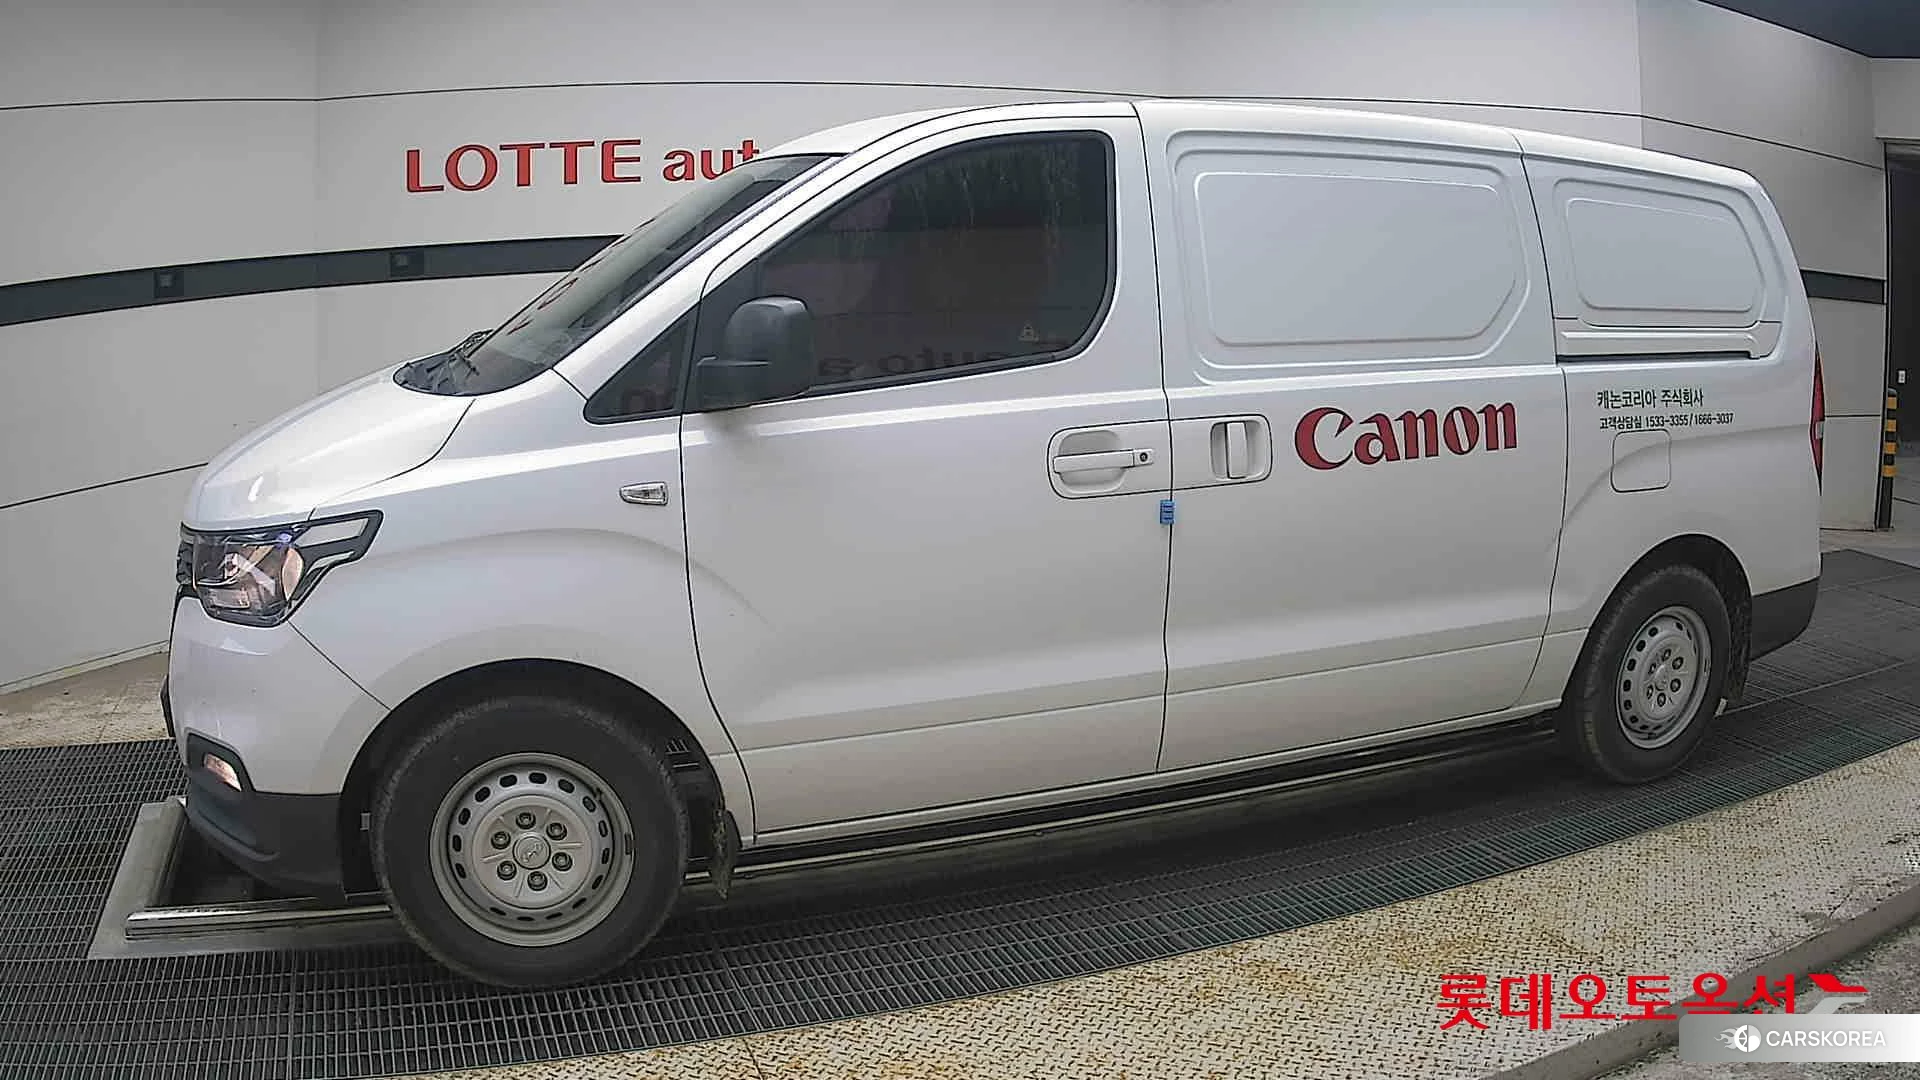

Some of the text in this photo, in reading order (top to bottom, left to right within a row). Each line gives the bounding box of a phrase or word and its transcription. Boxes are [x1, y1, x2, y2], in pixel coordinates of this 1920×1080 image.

[406, 138, 758, 193] LOTTE aut
[1597, 387, 1705, 409] 캐논코리아 주식회사
[1295, 402, 1517, 470] Canon
